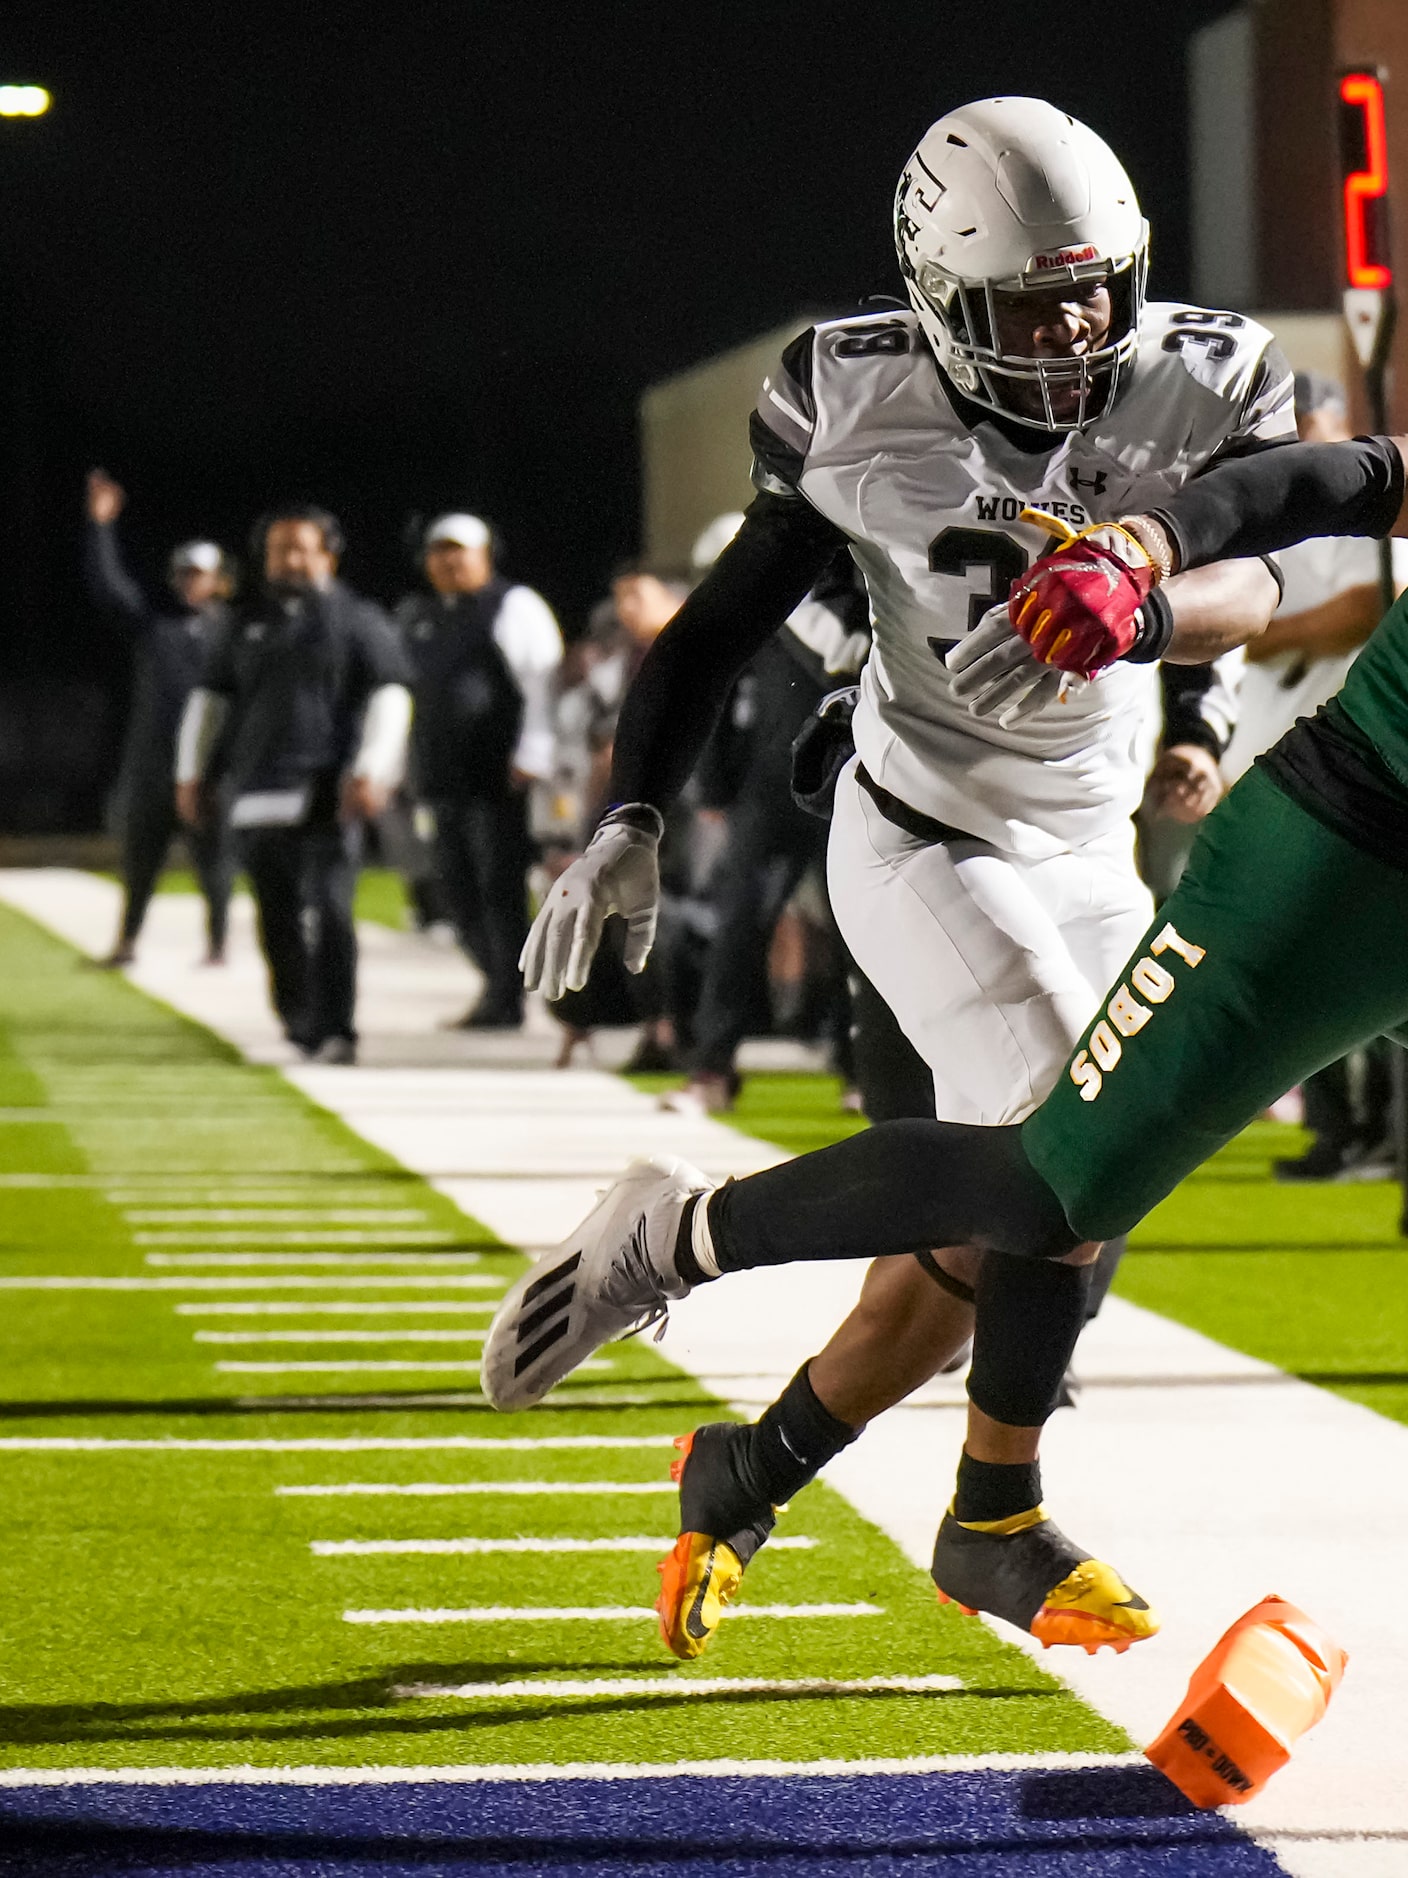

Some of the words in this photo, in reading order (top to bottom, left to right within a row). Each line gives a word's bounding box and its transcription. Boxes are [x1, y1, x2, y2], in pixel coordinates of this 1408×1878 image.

[1034, 245, 1095, 269] Riddell
[1340, 73, 1392, 290] 2
[1070, 921, 1207, 1102] LOBOS
